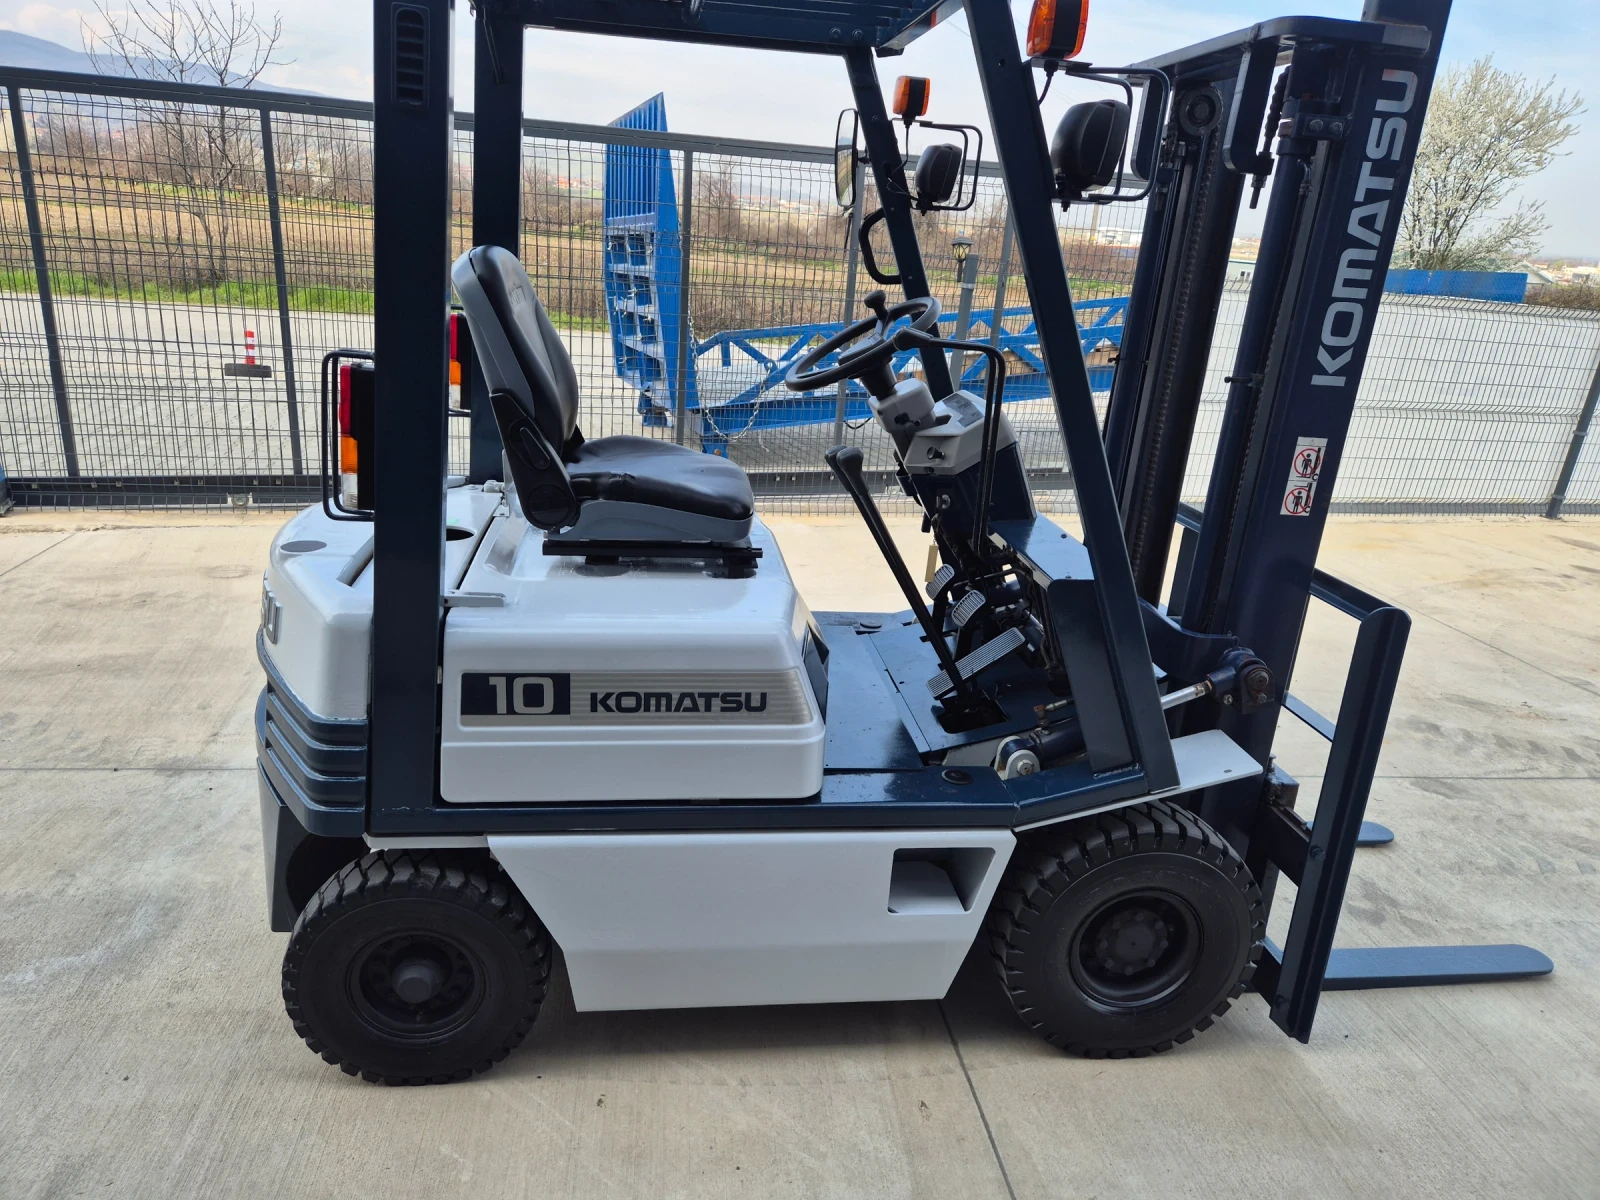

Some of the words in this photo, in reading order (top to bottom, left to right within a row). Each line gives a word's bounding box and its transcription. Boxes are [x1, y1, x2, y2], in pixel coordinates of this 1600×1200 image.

[1310, 68, 1418, 387] KOMATSU
[489, 676, 554, 714] 10
[589, 691, 767, 713] KOMATSU
